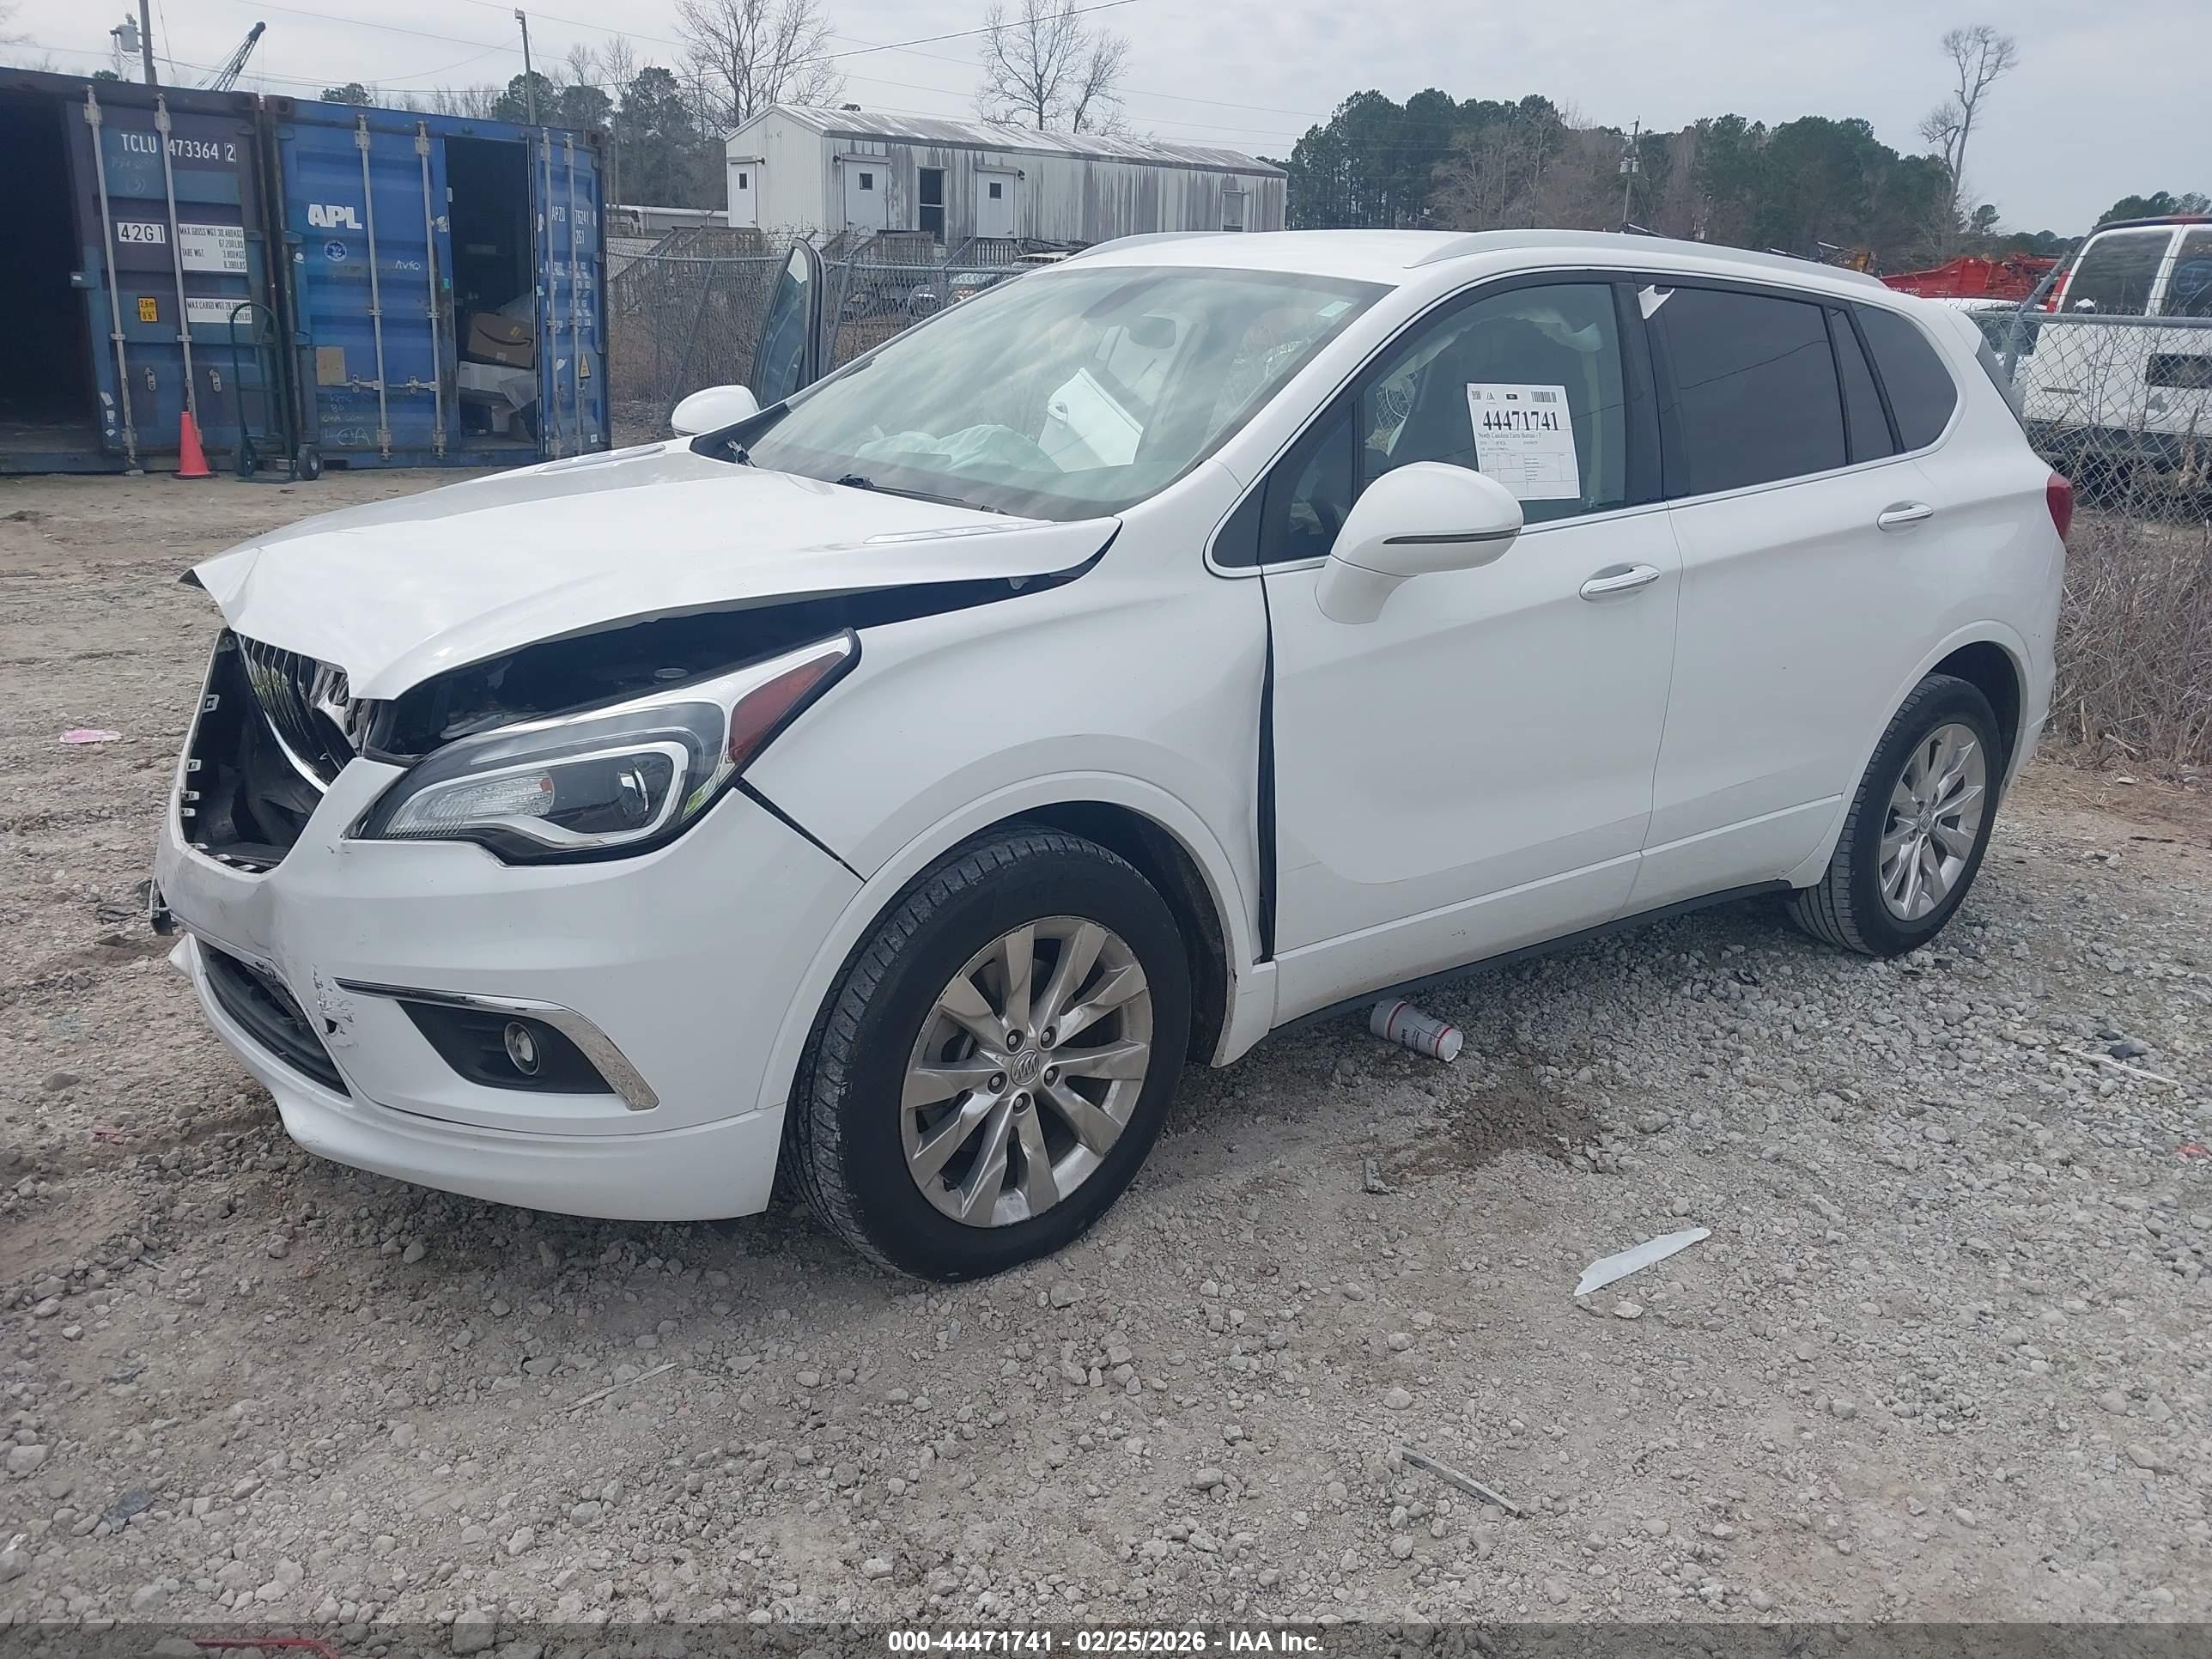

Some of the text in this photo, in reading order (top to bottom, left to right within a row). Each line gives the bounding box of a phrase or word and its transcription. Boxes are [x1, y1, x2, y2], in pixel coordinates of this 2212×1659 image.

[121, 133, 235, 161] TCLU 473364 2
[307, 204, 363, 230] APL
[121, 224, 164, 242] 42G1
[1482, 410, 1559, 431] 44471741
